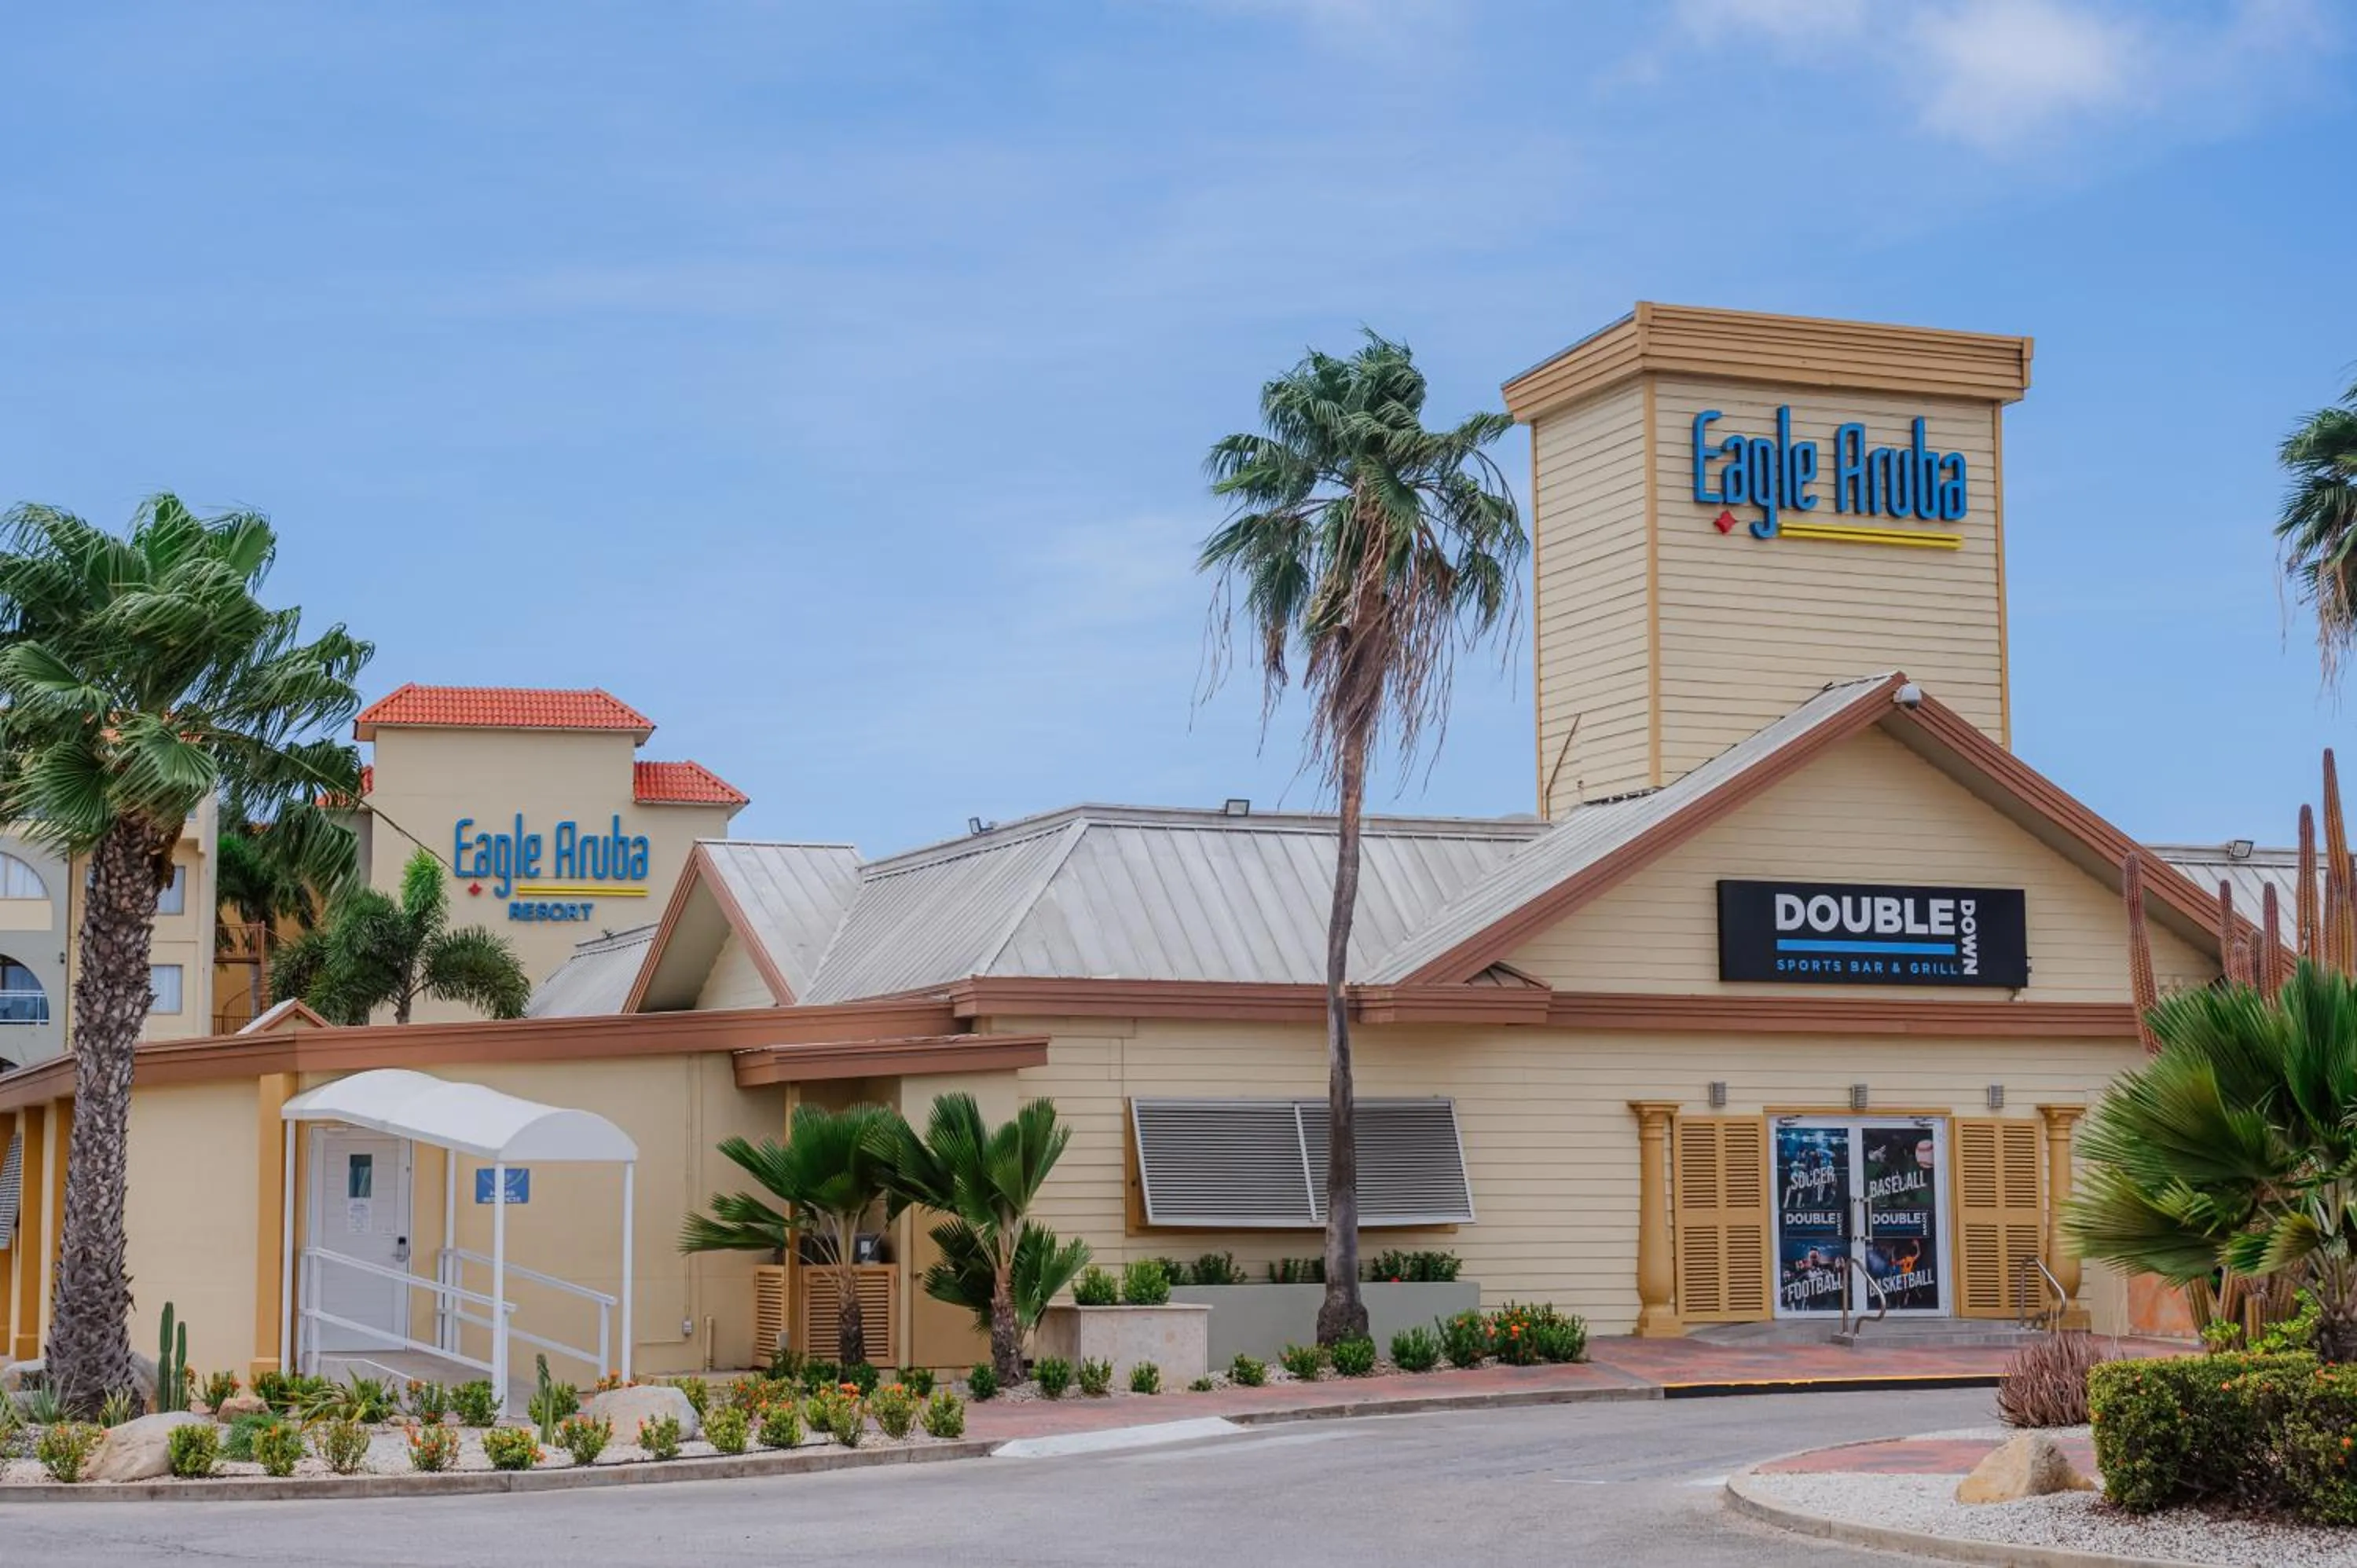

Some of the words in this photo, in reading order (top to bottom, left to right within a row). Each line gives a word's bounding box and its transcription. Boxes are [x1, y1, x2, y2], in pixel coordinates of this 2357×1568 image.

[1692, 404, 1819, 539] Eagle
[1835, 415, 1967, 521] Aruba
[454, 812, 542, 899] Eagle
[555, 814, 650, 881] Aruba
[508, 902, 594, 921] RESORT
[1774, 893, 1956, 935] DOUBLE
[1960, 899, 1978, 975] DOWN
[1776, 958, 1842, 972] SPORTS
[1850, 961, 1884, 973] BAR
[1892, 962, 1901, 973] &
[1910, 962, 1958, 975] GRILL
[1786, 1212, 1836, 1225] DOUBLE
[1872, 1212, 1921, 1225] DOUBLE
[1787, 1272, 1843, 1302] FOOTBALL
